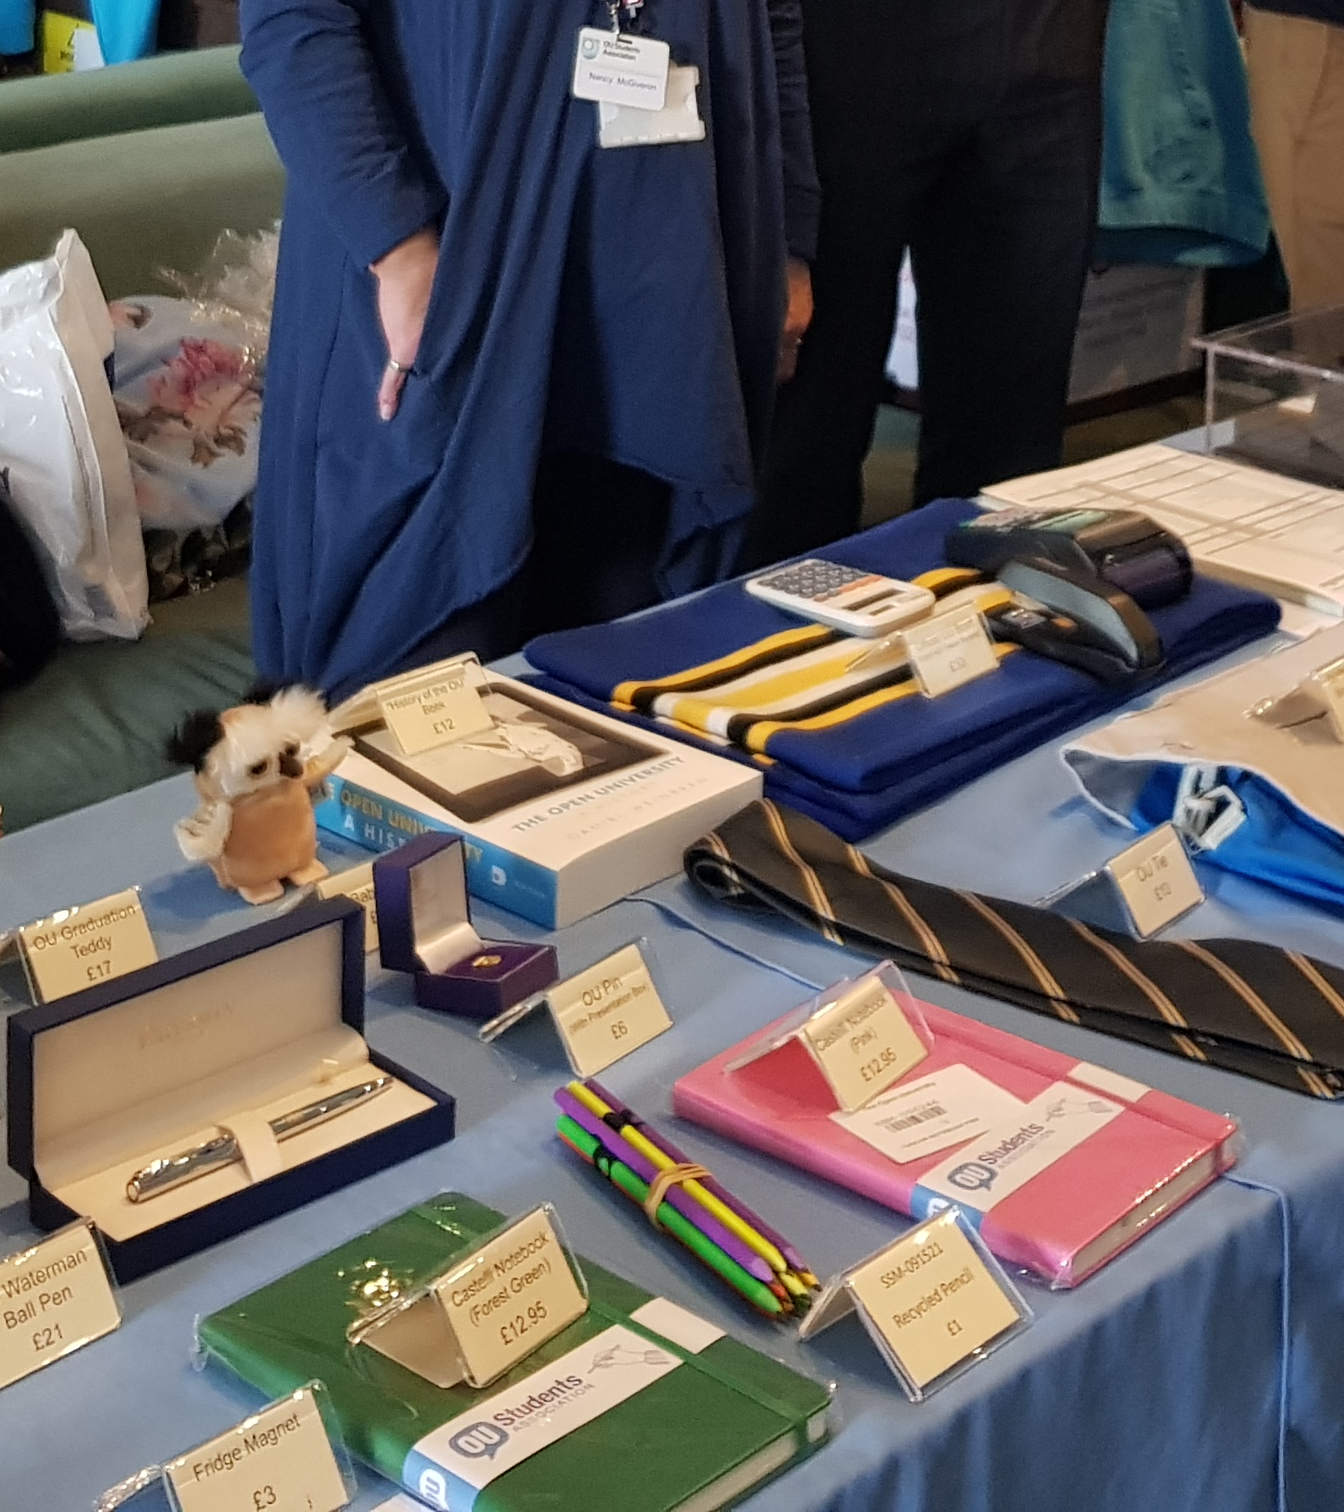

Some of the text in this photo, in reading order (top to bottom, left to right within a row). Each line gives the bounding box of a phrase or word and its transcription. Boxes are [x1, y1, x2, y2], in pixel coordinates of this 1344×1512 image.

[433, 718, 455, 735] £12
[512, 756, 685, 833] THE OPEN UNIVERSITY
[33, 904, 136, 951] OU Graduation
[70, 935, 112, 960] Teddy
[87, 960, 112, 982] £17
[582, 989, 602, 1006] OU
[611, 1020, 628, 1040] £6
[860, 1047, 897, 1083] £12.95
[953, 1165, 992, 1188] OU
[978, 1123, 1045, 1165] Students
[1, 1249, 88, 1300] Waterman
[494, 1230, 550, 1278] Notebook
[3, 1285, 74, 1330] Ball Pen
[469, 1258, 552, 1328] (Forest Green)
[892, 1266, 974, 1329] Recycled Pencil
[32, 1323, 64, 1352] £21
[500, 1299, 549, 1347] £12.95
[946, 1318, 963, 1338] £1
[457, 1375, 584, 1455] OU Students
[193, 1413, 301, 1482] Fridge Magnet
[253, 1485, 278, 1511] £3
